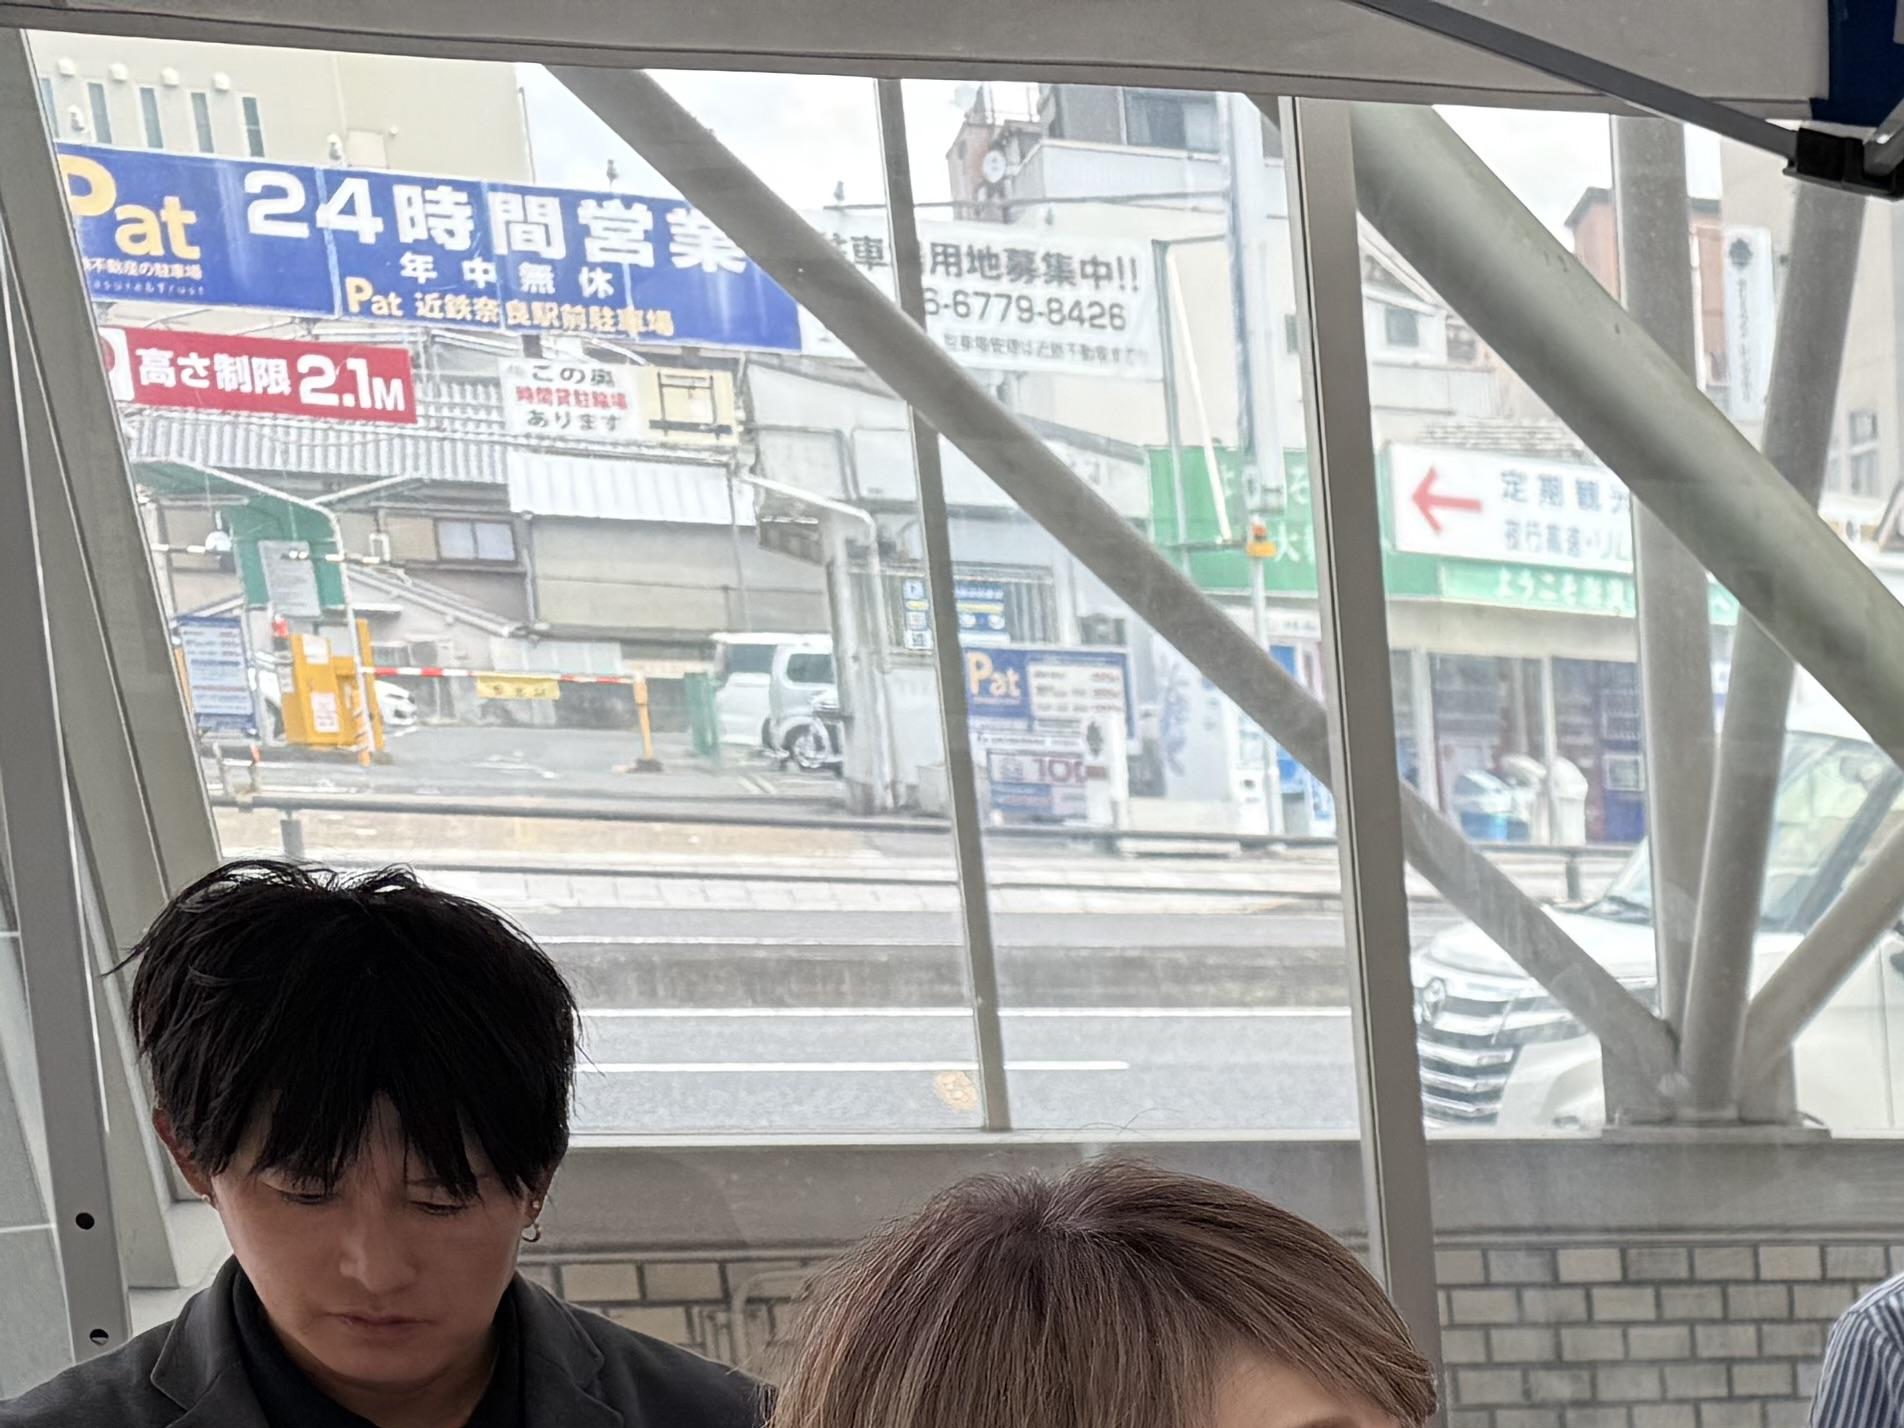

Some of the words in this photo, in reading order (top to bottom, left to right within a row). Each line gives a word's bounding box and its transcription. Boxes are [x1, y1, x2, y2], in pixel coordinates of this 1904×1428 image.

[57, 154, 200, 259] Pat
[245, 170, 746, 273] 24時間営業
[400, 252, 614, 298] 年中無休
[832, 233, 1138, 292] 車用地募集中!!
[345, 277, 403, 317] Pat
[415, 292, 674, 337] 近鉄奈良駅前駐車場
[136, 348, 292, 396] 高さ制限
[297, 354, 405, 411] 2.1M
[527, 410, 621, 432] あります
[968, 652, 1021, 698] Pat
